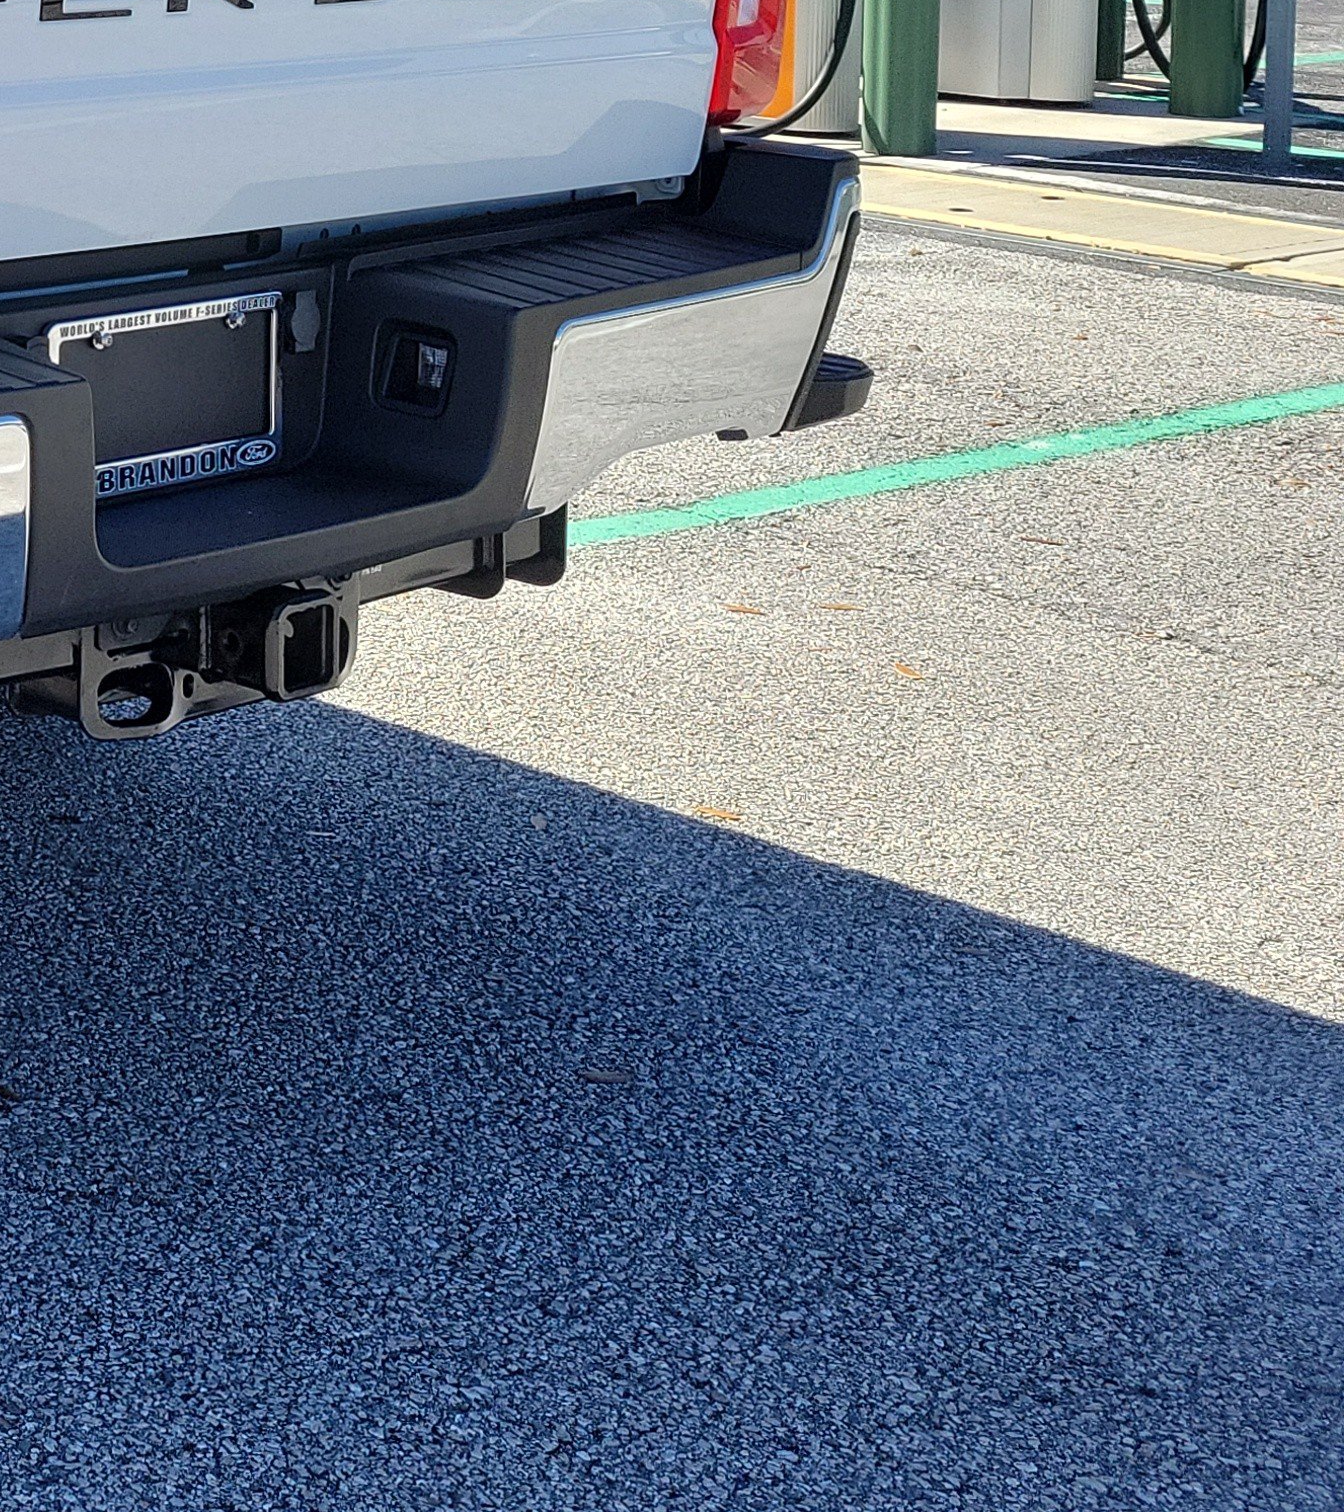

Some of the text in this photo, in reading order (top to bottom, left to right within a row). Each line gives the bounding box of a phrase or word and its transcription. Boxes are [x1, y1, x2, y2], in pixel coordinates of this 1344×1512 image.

[60, 295, 276, 338] WORLD'S LARGEST VOLUME F-SERIES DEALER
[97, 445, 238, 495] BRANDON
